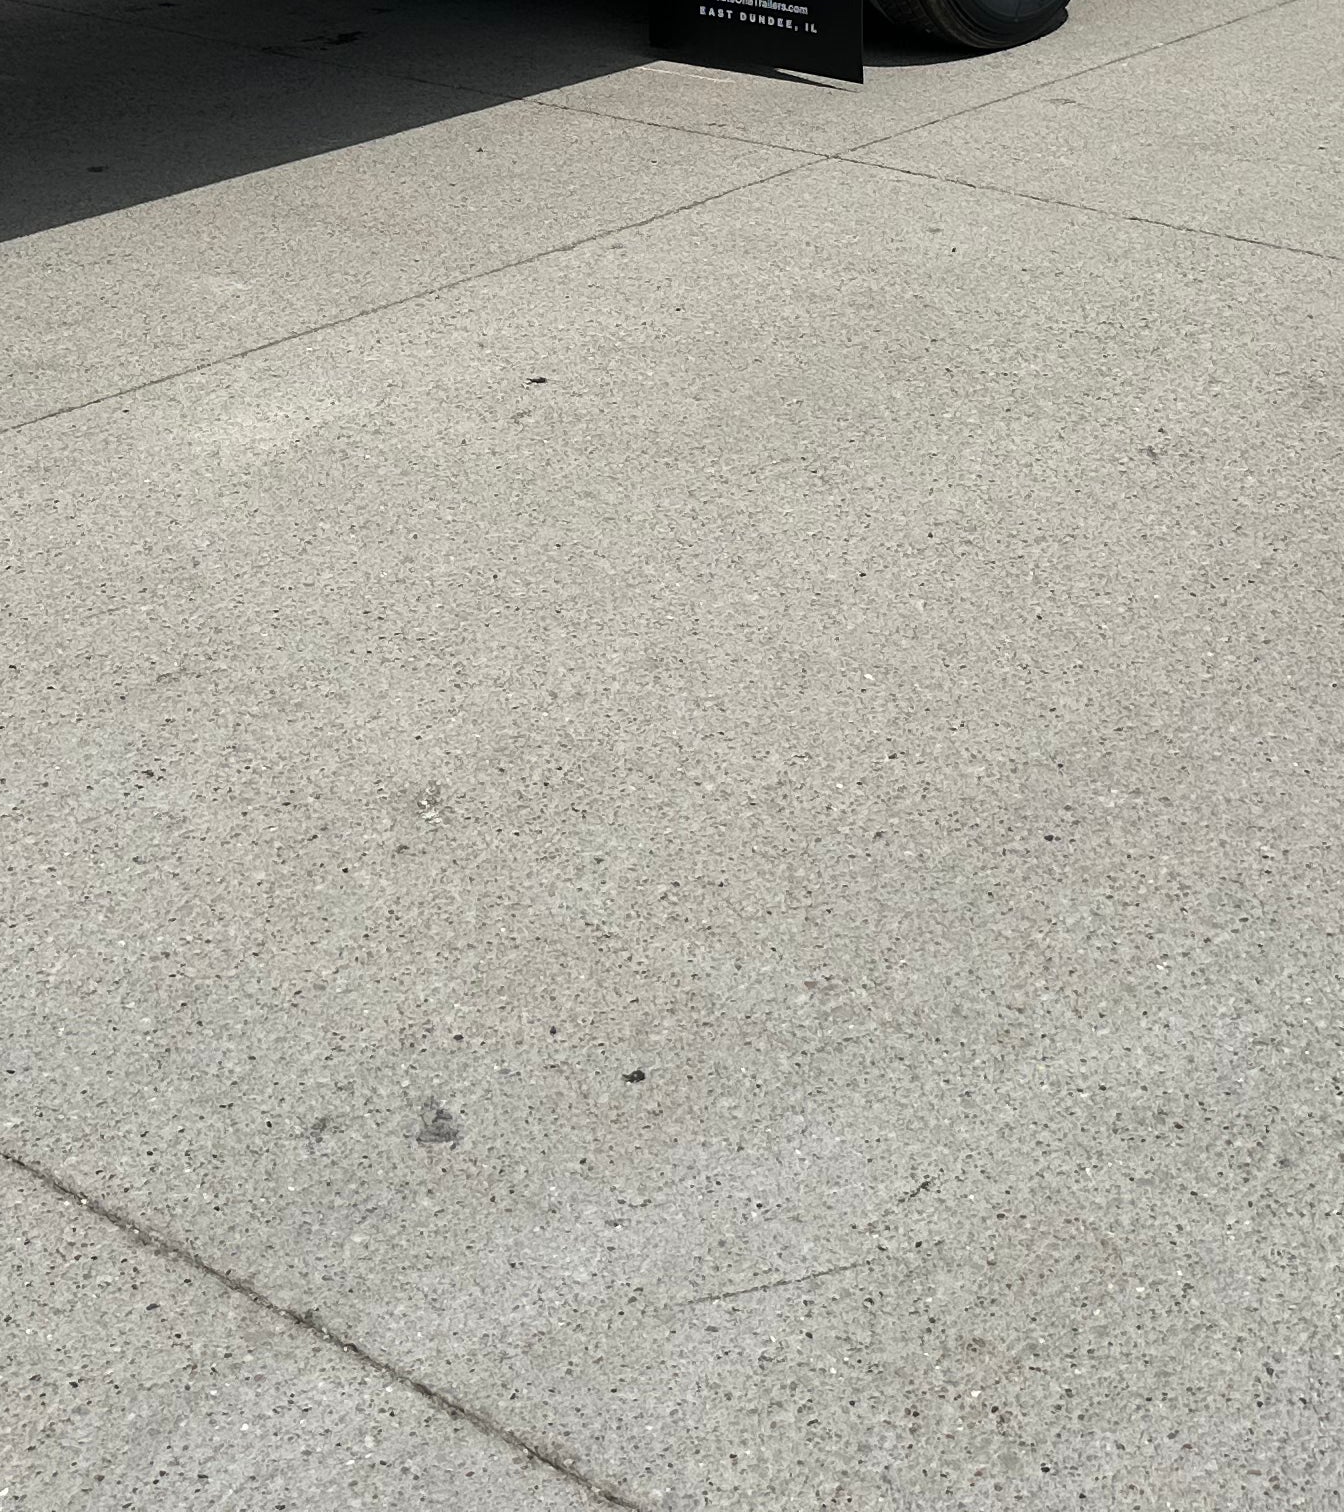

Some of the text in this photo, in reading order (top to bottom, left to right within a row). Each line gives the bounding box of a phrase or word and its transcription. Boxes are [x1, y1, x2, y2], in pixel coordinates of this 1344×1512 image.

[699, 6, 818, 34] EAST DUNDEE, IL
